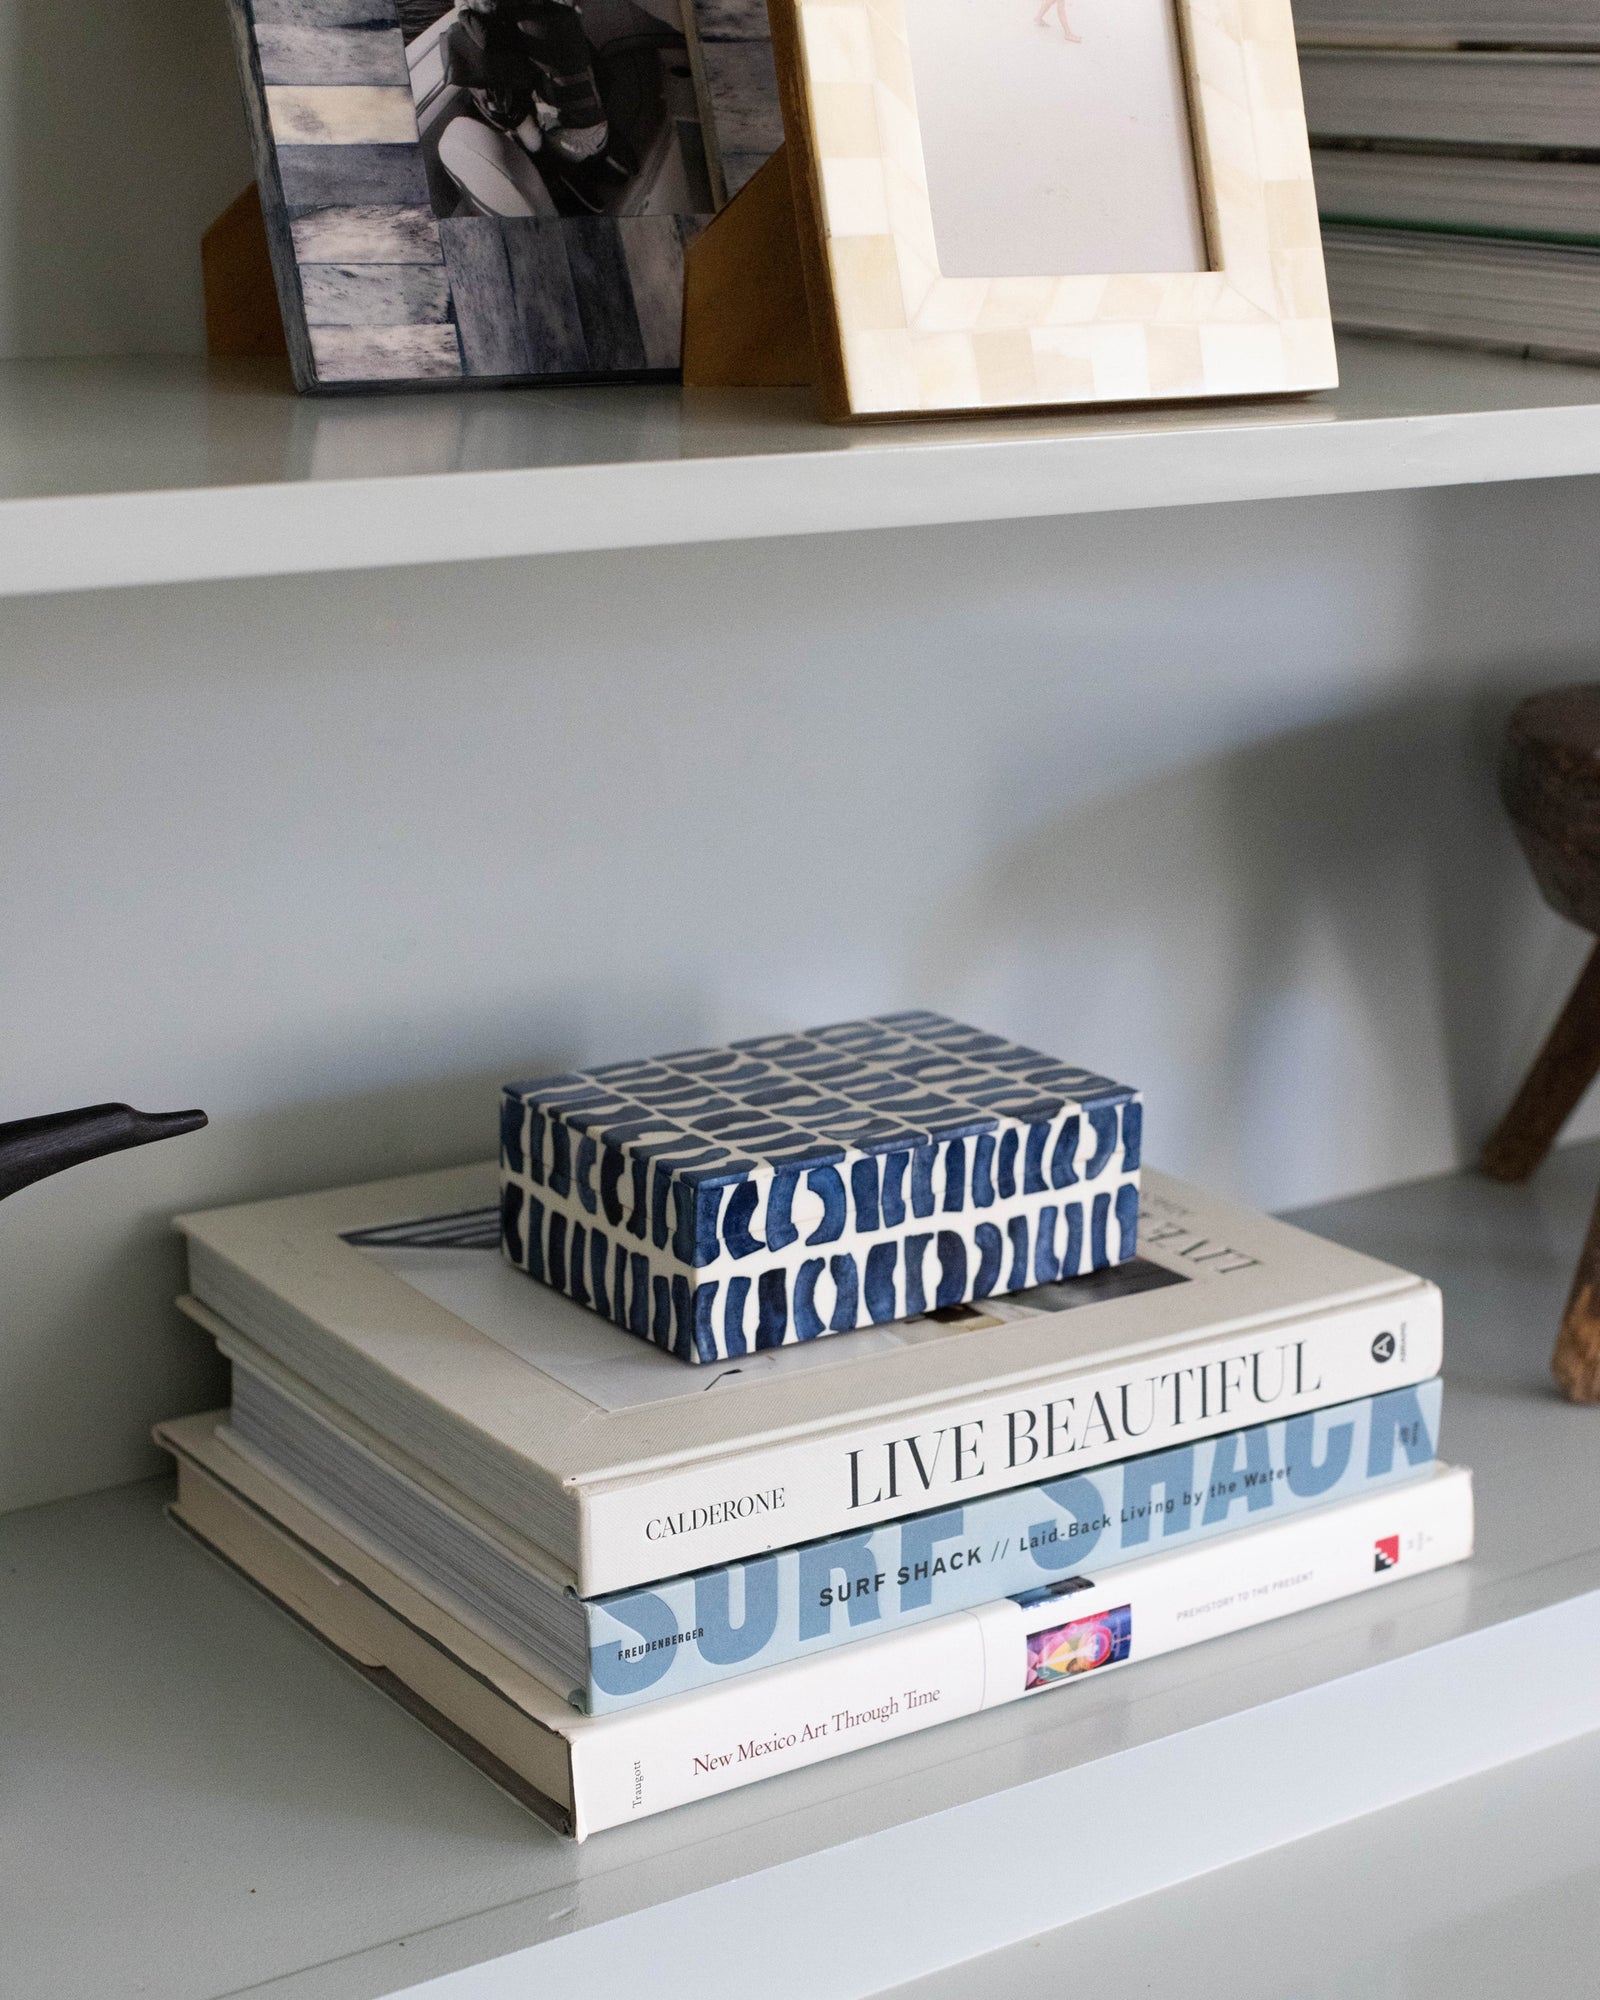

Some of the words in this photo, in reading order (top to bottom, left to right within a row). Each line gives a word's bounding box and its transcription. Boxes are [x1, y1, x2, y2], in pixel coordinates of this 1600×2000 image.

[845, 1419, 985, 1510] LIVE
[1002, 1340, 1323, 1470] BEAUTIFUL
[645, 1487, 786, 1542] CALDERONE
[819, 1572, 886, 1608] SURF
[896, 1546, 983, 1586] SHACK
[1019, 1513, 1112, 1551] Laid-Back
[1120, 1499, 1175, 1524] Living
[1183, 1490, 1203, 1507] by
[1209, 1479, 1237, 1497] the
[1244, 1465, 1293, 1488] Water
[590, 1504, 964, 1697] SURF
[1176, 1596, 1236, 1621] PREHISTORY
[1238, 1590, 1251, 1602] TO
[1252, 1584, 1269, 1598] THE
[1272, 1571, 1314, 1592] PRESENT
[618, 1627, 705, 1661] FREUDENBERGER
[692, 1751, 734, 1777] New
[737, 1732, 797, 1764] Mexico
[799, 1723, 829, 1744] Art
[831, 1695, 899, 1732] Through
[903, 1687, 942, 1710] Time
[632, 1760, 642, 1809] Traugott
